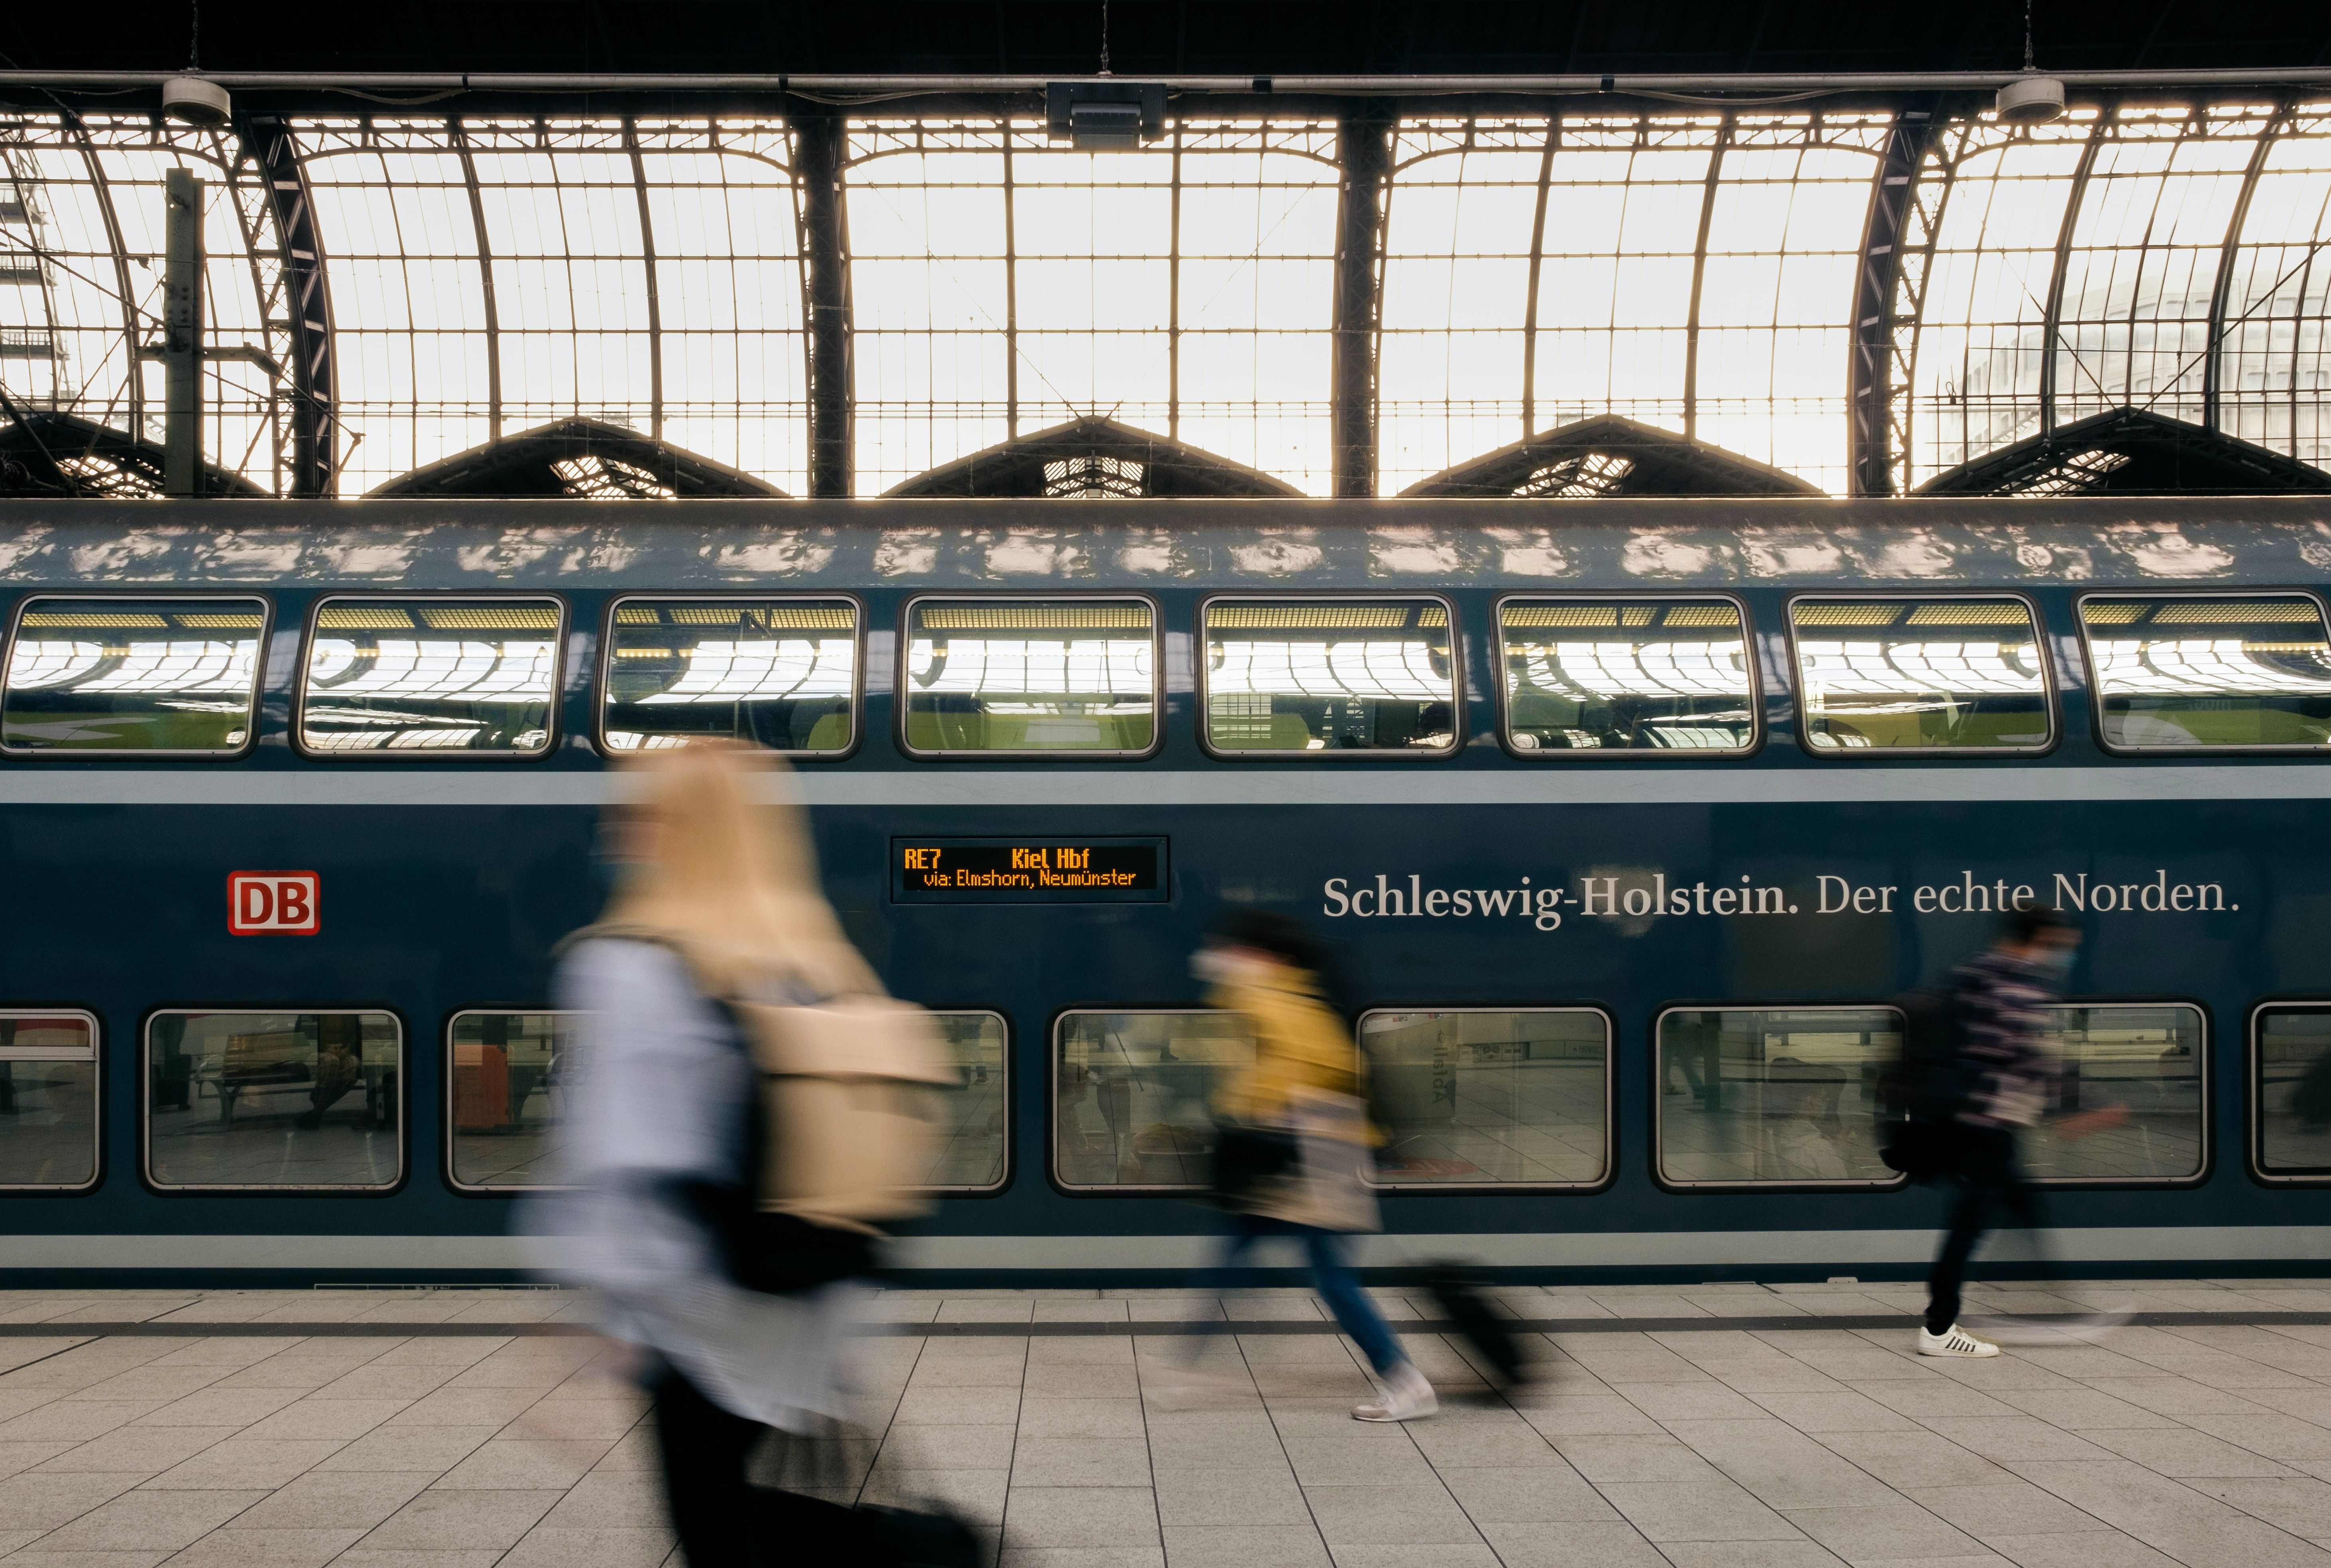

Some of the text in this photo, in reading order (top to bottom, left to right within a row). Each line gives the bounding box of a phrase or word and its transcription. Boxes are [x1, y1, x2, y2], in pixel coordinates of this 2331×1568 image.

[905, 848, 1089, 869] RE7 Kiel Hbf
[924, 869, 1136, 889] via: Elmshorn, Neumünster
[241, 882, 309, 924] DB
[1324, 869, 2239, 931] Schleswig-Holstein. Der echte Norden.
